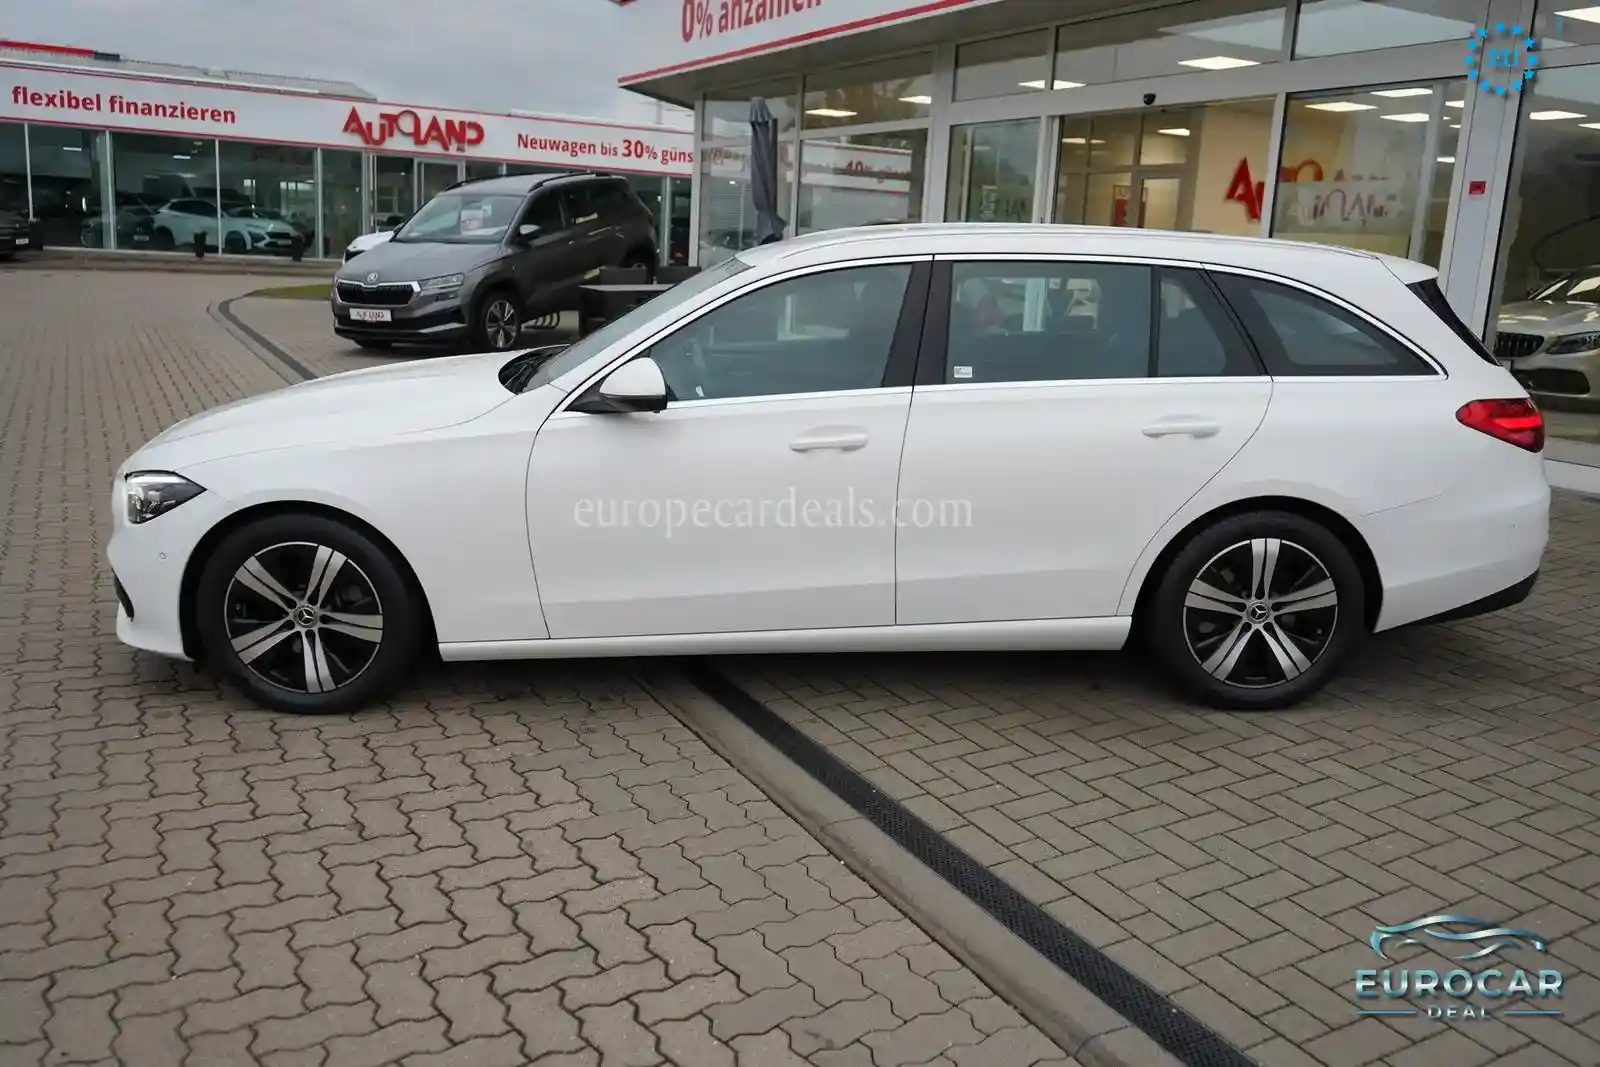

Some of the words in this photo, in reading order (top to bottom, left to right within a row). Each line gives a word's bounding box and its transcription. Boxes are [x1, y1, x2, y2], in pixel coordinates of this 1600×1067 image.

[681, 0, 713, 43] 0%
[718, 0, 821, 33] anza
[12, 86, 102, 112] flexibel
[109, 95, 236, 124] finanzieren
[517, 133, 596, 157] Neuwagen
[600, 142, 618, 157] bis
[622, 139, 658, 160] 30%
